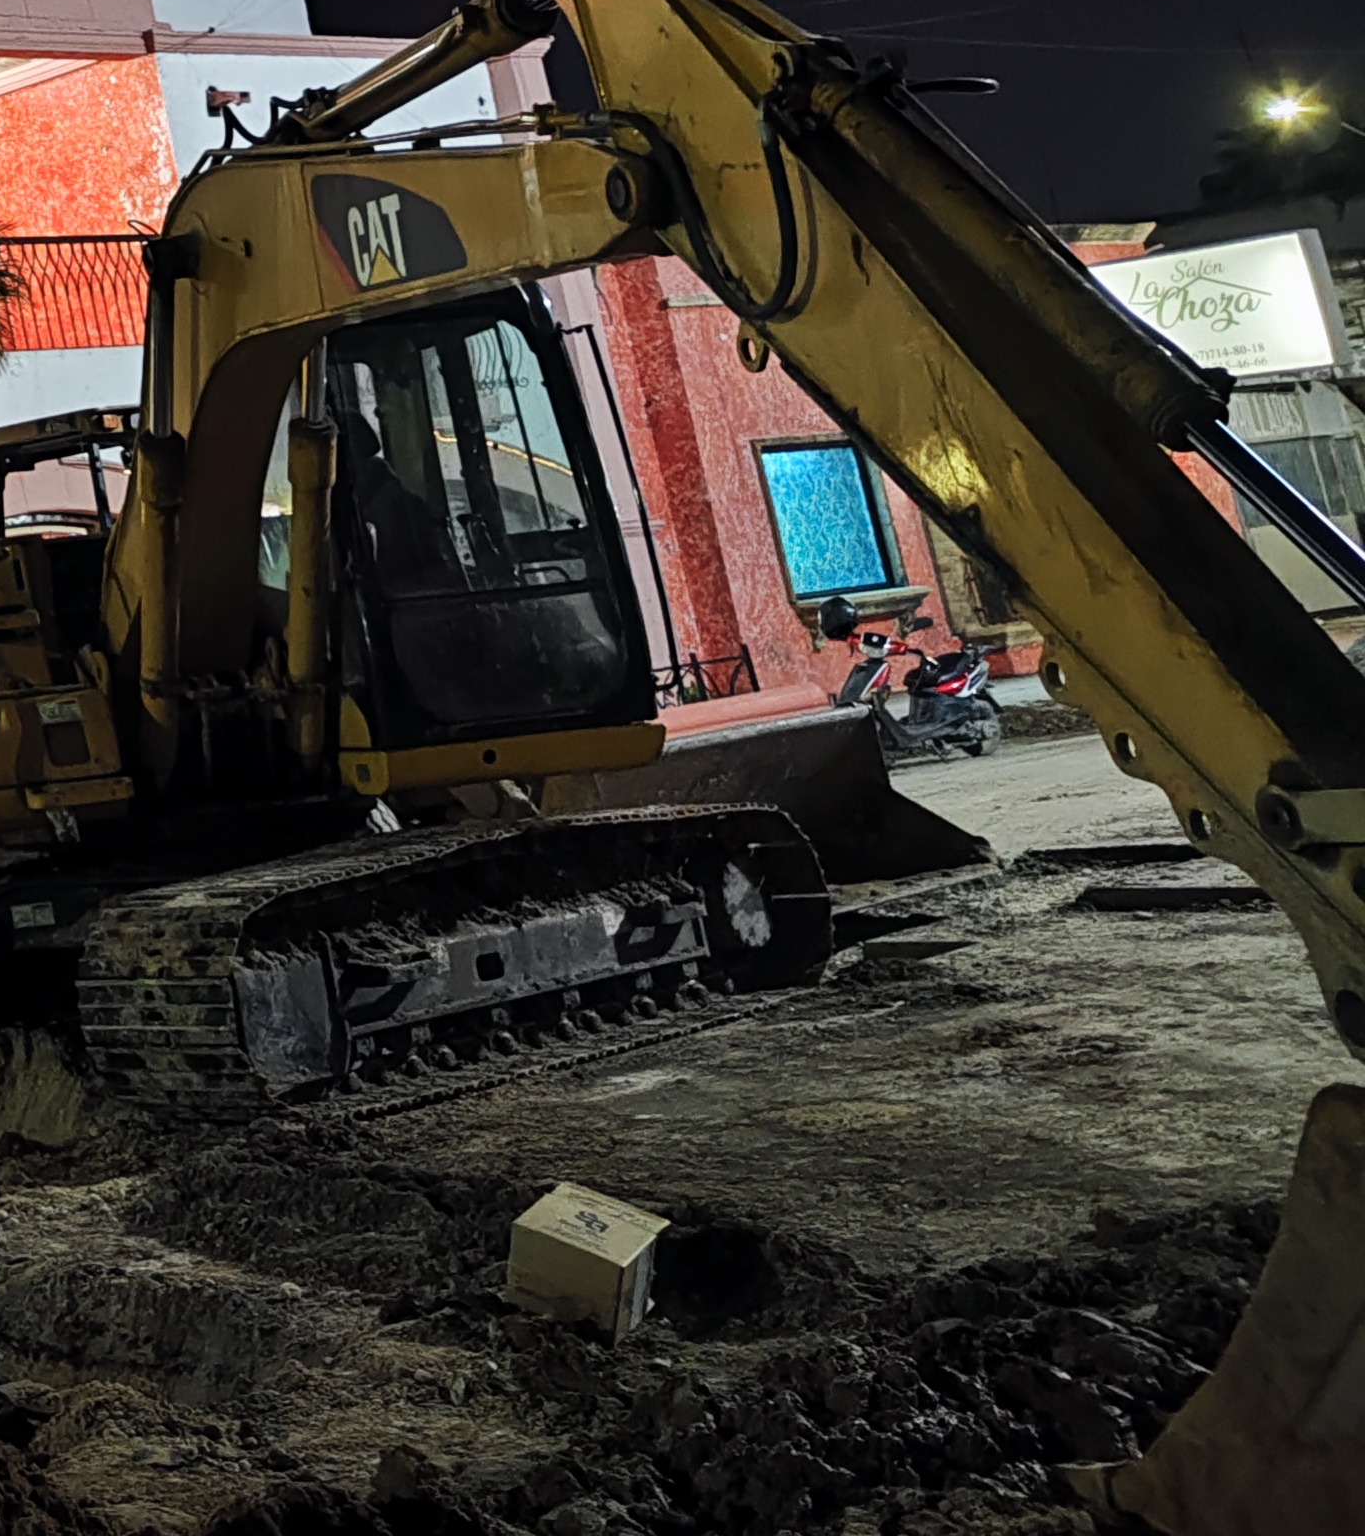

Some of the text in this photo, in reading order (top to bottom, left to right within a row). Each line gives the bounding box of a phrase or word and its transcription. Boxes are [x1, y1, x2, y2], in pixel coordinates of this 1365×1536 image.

[346, 193, 408, 287] CAT
[1128, 271, 1166, 306] La
[1170, 259, 1226, 283] Salón
[1153, 285, 1262, 333] Choza
